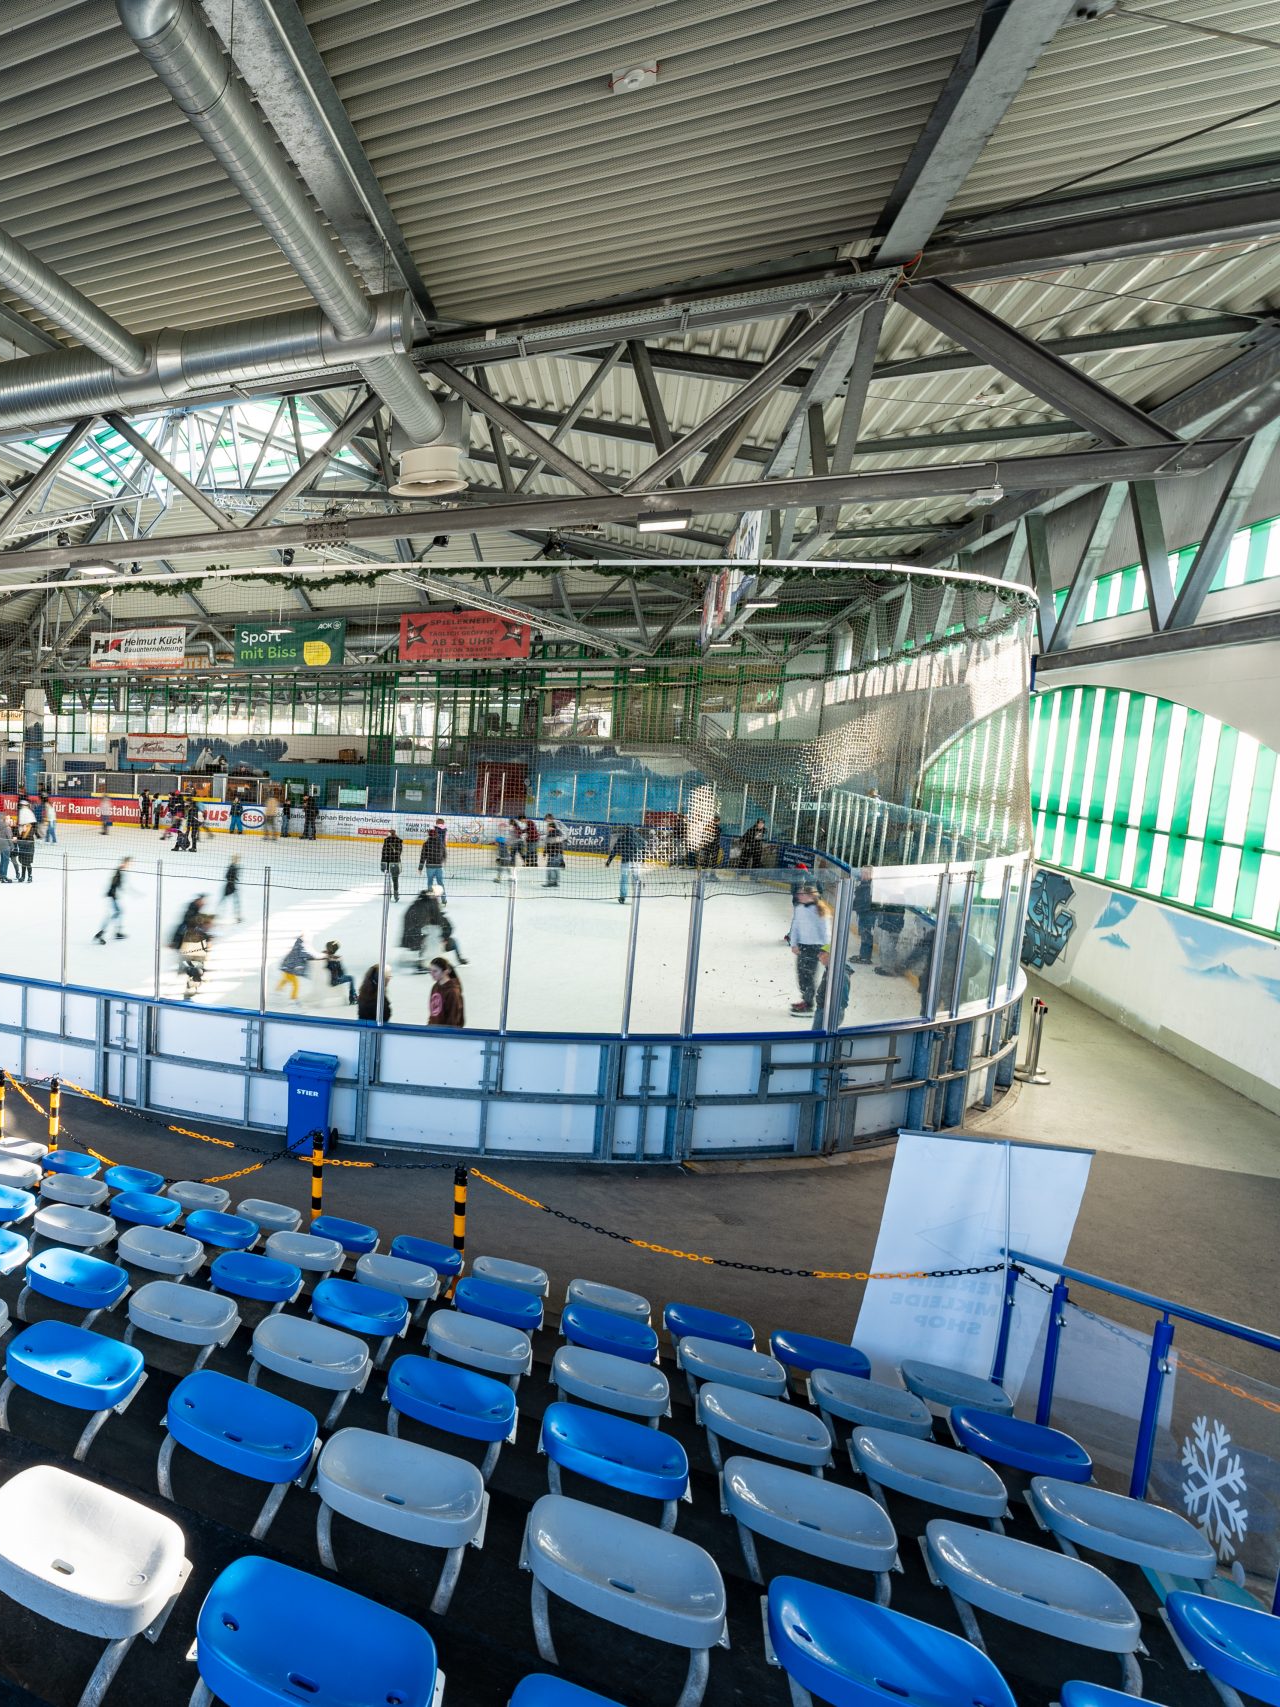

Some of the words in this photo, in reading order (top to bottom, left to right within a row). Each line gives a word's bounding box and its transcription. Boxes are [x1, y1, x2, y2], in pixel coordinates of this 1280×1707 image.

[125, 637, 156, 647] Helmut
[159, 636, 183, 646] Kück
[241, 631, 281, 646] Sport
[451, 638, 465, 646] 19
[469, 637, 494, 645] UHR
[124, 645, 183, 654] Bauunternehmung
[241, 647, 264, 659] mit
[267, 645, 297, 658] Biss
[53, 801, 66, 812] für
[68, 803, 152, 818] Raumgstaltun!
[584, 825, 597, 836] Du
[567, 836, 604, 847] Strecke?
[296, 1088, 319, 1098] STIER
